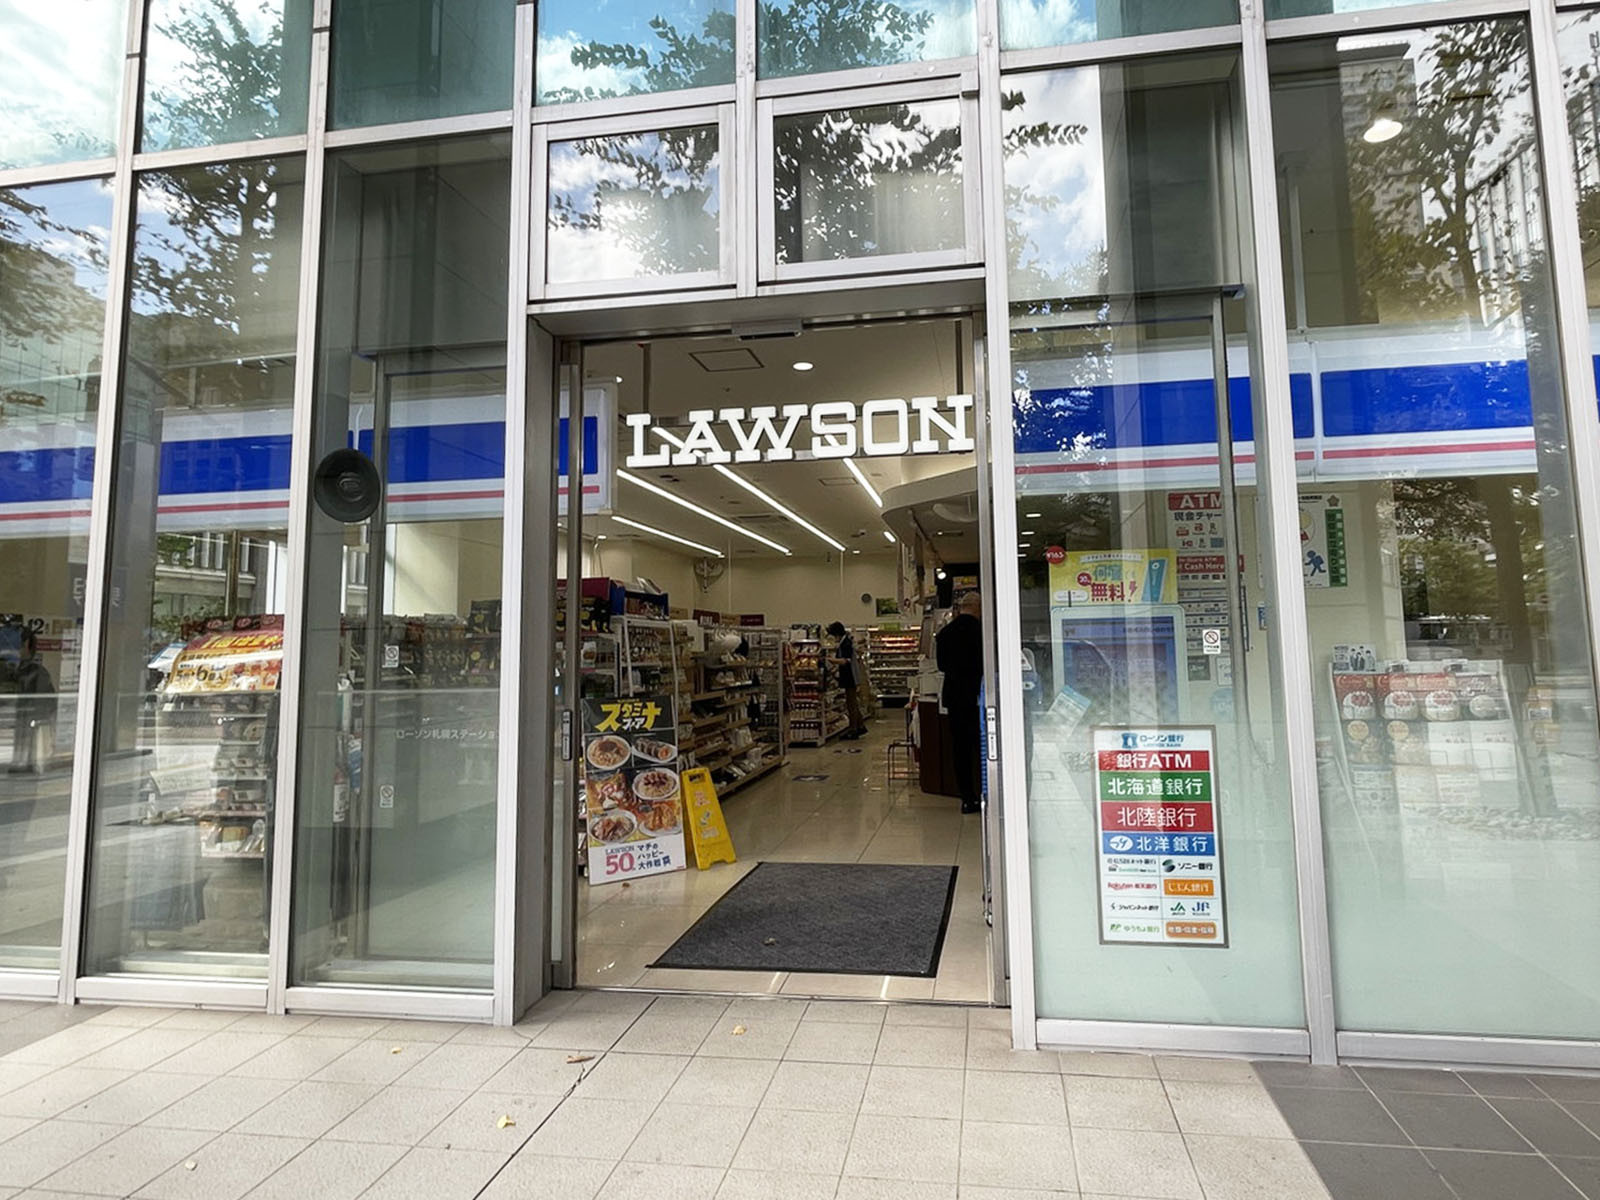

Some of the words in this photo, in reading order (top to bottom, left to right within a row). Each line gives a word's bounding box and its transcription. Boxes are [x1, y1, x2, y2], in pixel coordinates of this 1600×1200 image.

[626, 394, 975, 468] LAWSON
[1180, 493, 1222, 509] ATM
[1140, 734, 1185, 743] ローソン銀行
[1116, 753, 1192, 769] 銀行ATM
[1107, 777, 1204, 796] 北海道銀行
[1117, 807, 1198, 828] 北陸銀行
[1136, 836, 1209, 853] 北洋銀行
[606, 852, 635, 876] 50
